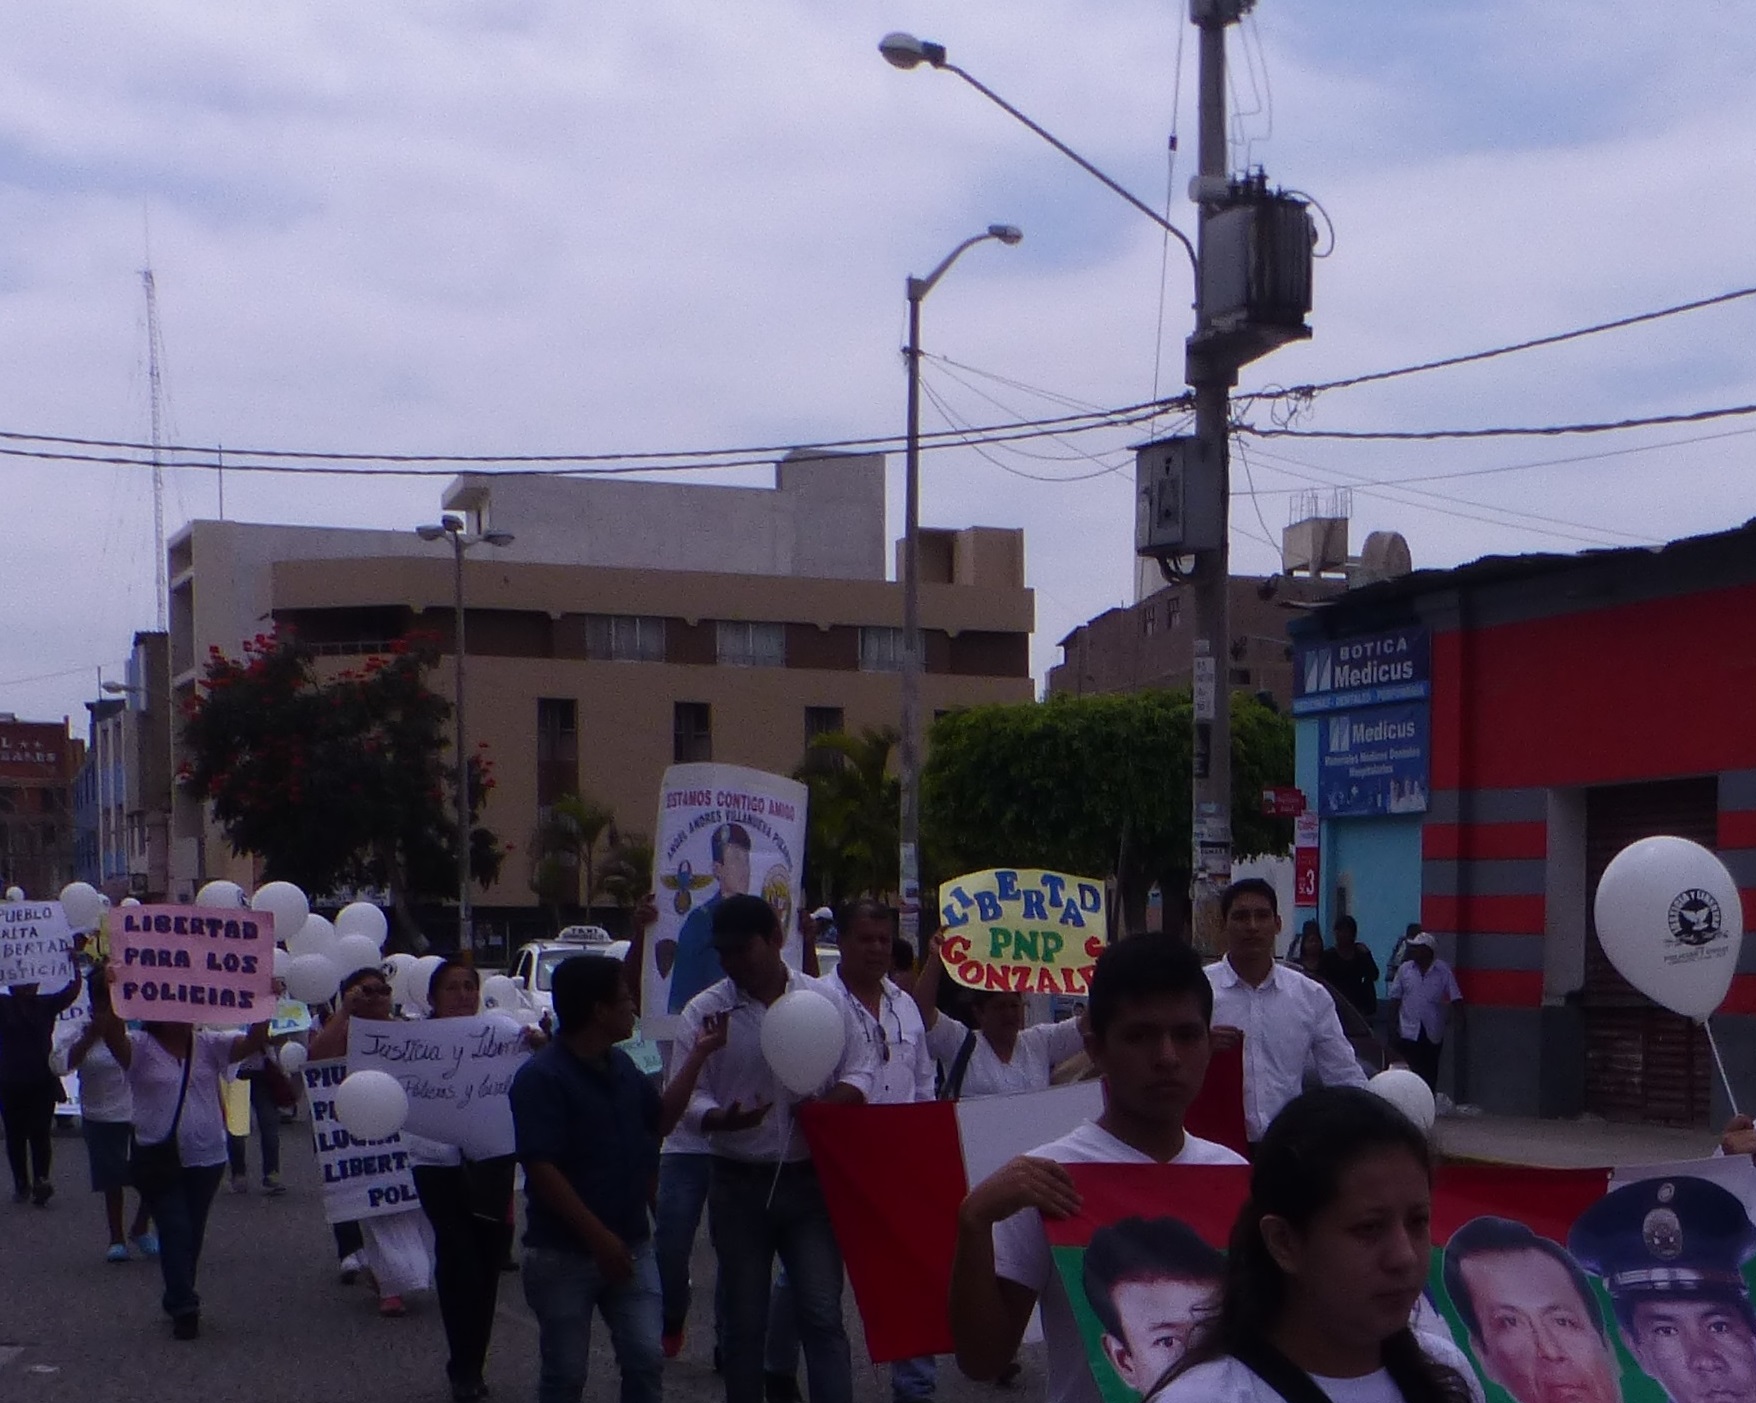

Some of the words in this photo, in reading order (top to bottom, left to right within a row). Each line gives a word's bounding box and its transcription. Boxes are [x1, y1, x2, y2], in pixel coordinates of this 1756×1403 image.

[1340, 637, 1407, 661] BOTICA
[1334, 660, 1414, 689] Medicus
[1352, 720, 1416, 745] Medicus
[942, 871, 1101, 928] LIBERTAD
[124, 915, 259, 940] LIBERTAD
[989, 927, 1064, 963] PNP
[125, 947, 191, 968] PARA
[207, 952, 258, 974] LOS
[123, 981, 255, 1009] POLICIAS
